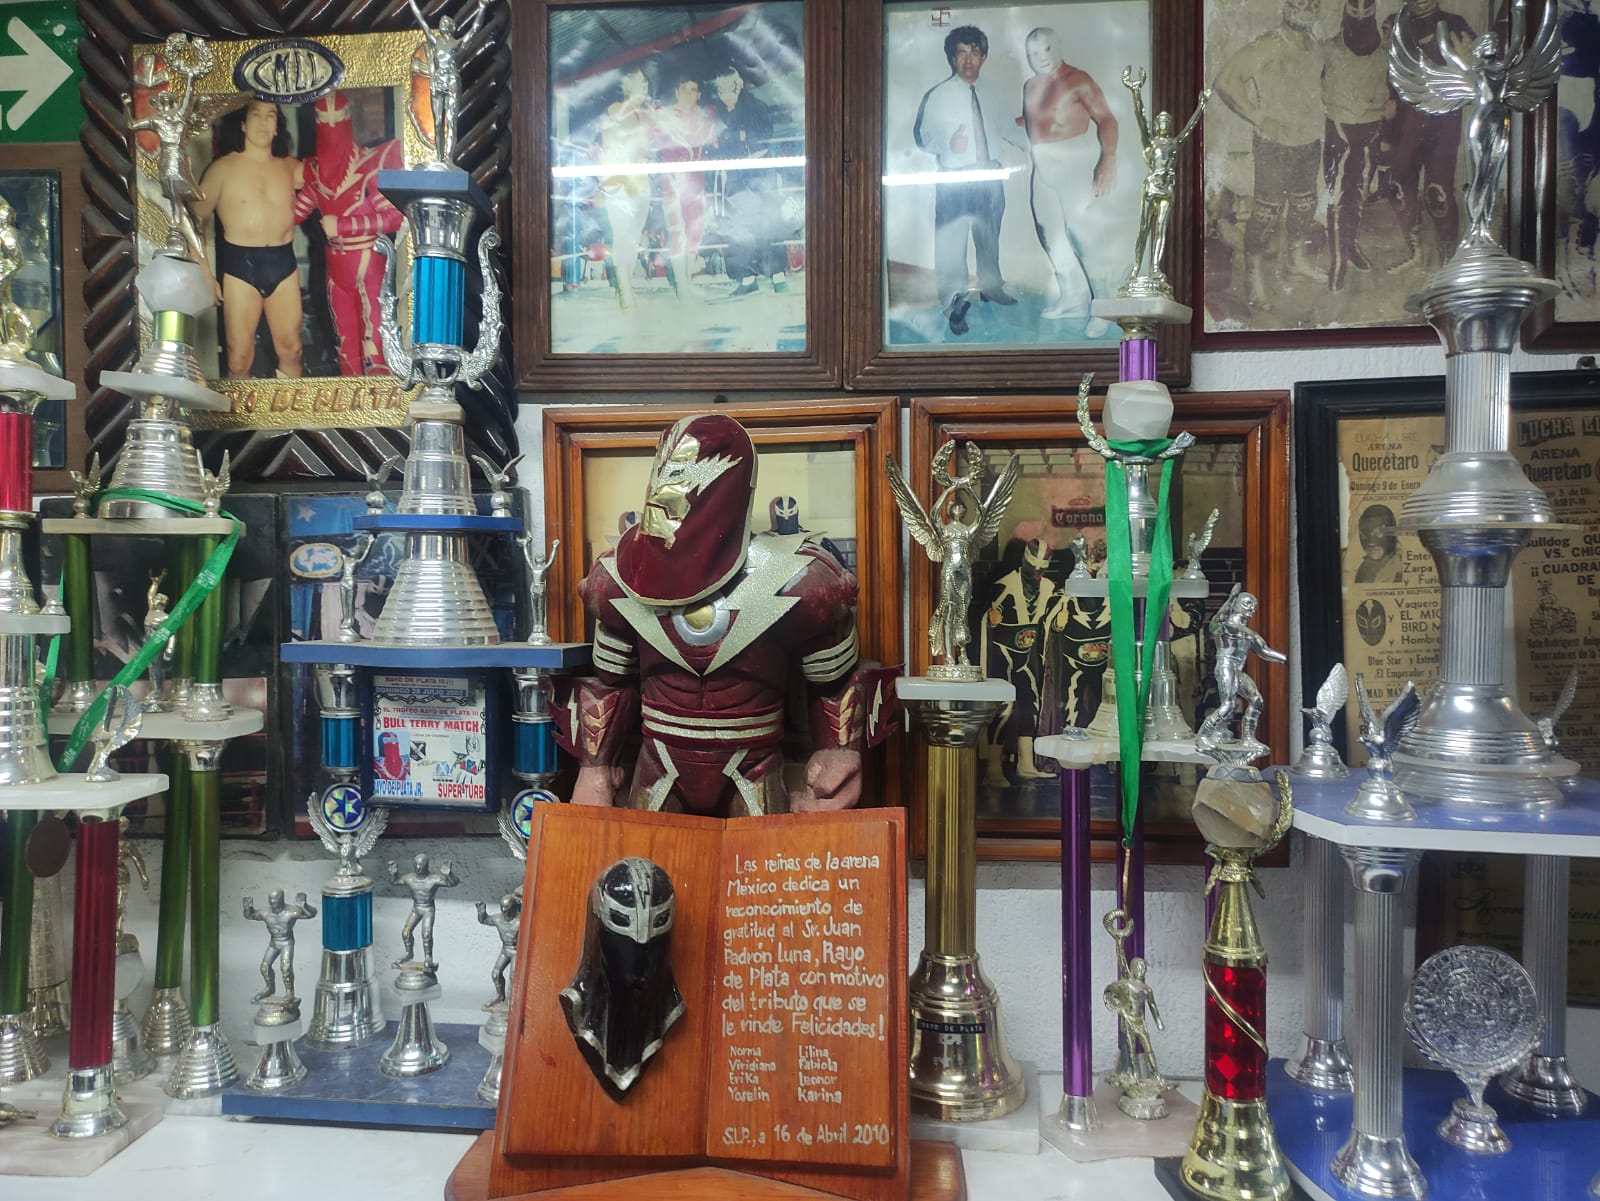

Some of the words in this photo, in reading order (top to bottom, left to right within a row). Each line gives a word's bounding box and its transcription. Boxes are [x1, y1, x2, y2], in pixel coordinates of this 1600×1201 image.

[270, 388, 307, 412] DE
[312, 387, 403, 412] PLATA
[1518, 416, 1575, 447] LUCHA
[1367, 442, 1403, 452] ARENA
[1530, 448, 1580, 461] ARENA
[1055, 512, 1104, 524] Corona
[1544, 547, 1566, 559] VS.
[1402, 562, 1433, 576] Zarpa
[1576, 574, 1595, 586] DE
[1394, 598, 1439, 609] Vaquero
[1400, 610, 1413, 621] EL
[1401, 621, 1428, 633] BIRD
[383, 717, 406, 729] BULL
[410, 719, 441, 729] TERRY
[444, 720, 479, 732] MATCH
[374, 779, 387, 795] AYO
[464, 784, 486, 800] TURB
[735, 854, 758, 874] Las
[764, 853, 801, 872] reinas
[804, 852, 822, 871] de
[727, 878, 777, 896] México
[782, 875, 830, 892] dedica
[838, 878, 860, 891] un
[725, 898, 832, 918] reconocimiento
[843, 898, 863, 916] de
[723, 921, 776, 946] gratitud
[782, 920, 794, 938] al
[801, 918, 820, 938] Sr.
[822, 915, 862, 938] Juan
[723, 942, 773, 966] Padrón
[822, 939, 865, 970] Rayo
[722, 970, 743, 989] de
[749, 964, 790, 989] Plata
[799, 971, 827, 986] con
[830, 966, 885, 989] motivo
[721, 992, 745, 1012] del
[750, 989, 809, 1012] tributo
[812, 996, 843, 1017] que
[847, 995, 867, 1012] se
[721, 1013, 736, 1038] le
[740, 1013, 784, 1034] rinde
[791, 1012, 886, 1042] Felicidades!
[944, 1025, 955, 1033] DE
[959, 1025, 983, 1033] PLATA
[729, 1045, 762, 1057] Norma
[798, 1057, 838, 1073] Fabiola
[798, 1071, 838, 1087] Leonor
[797, 1086, 842, 1104] Karina
[758, 1131, 766, 1144] a
[773, 1124, 791, 1143] 16
[796, 1126, 813, 1145] de
[816, 1122, 848, 1145] Abril
[852, 1123, 891, 1146] 2010
